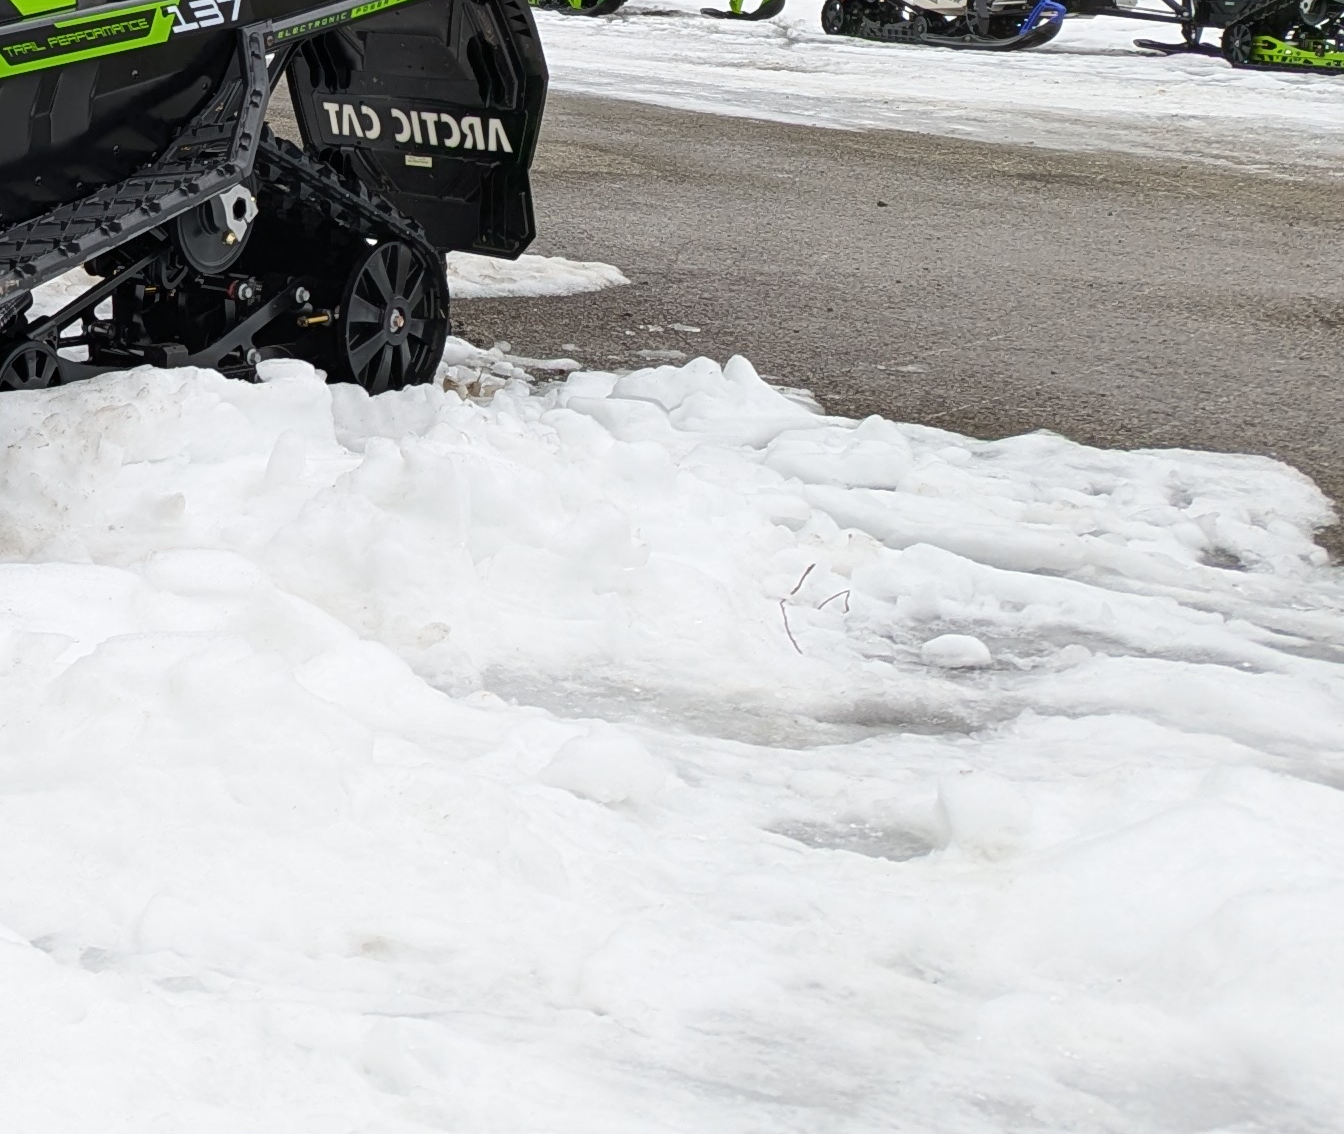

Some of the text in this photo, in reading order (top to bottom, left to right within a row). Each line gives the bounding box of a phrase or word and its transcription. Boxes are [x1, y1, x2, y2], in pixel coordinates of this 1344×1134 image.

[3, 40, 47, 58] TRAIL
[48, 17, 150, 49] PERFORMANCE
[277, 12, 348, 40] ELECTRONIC
